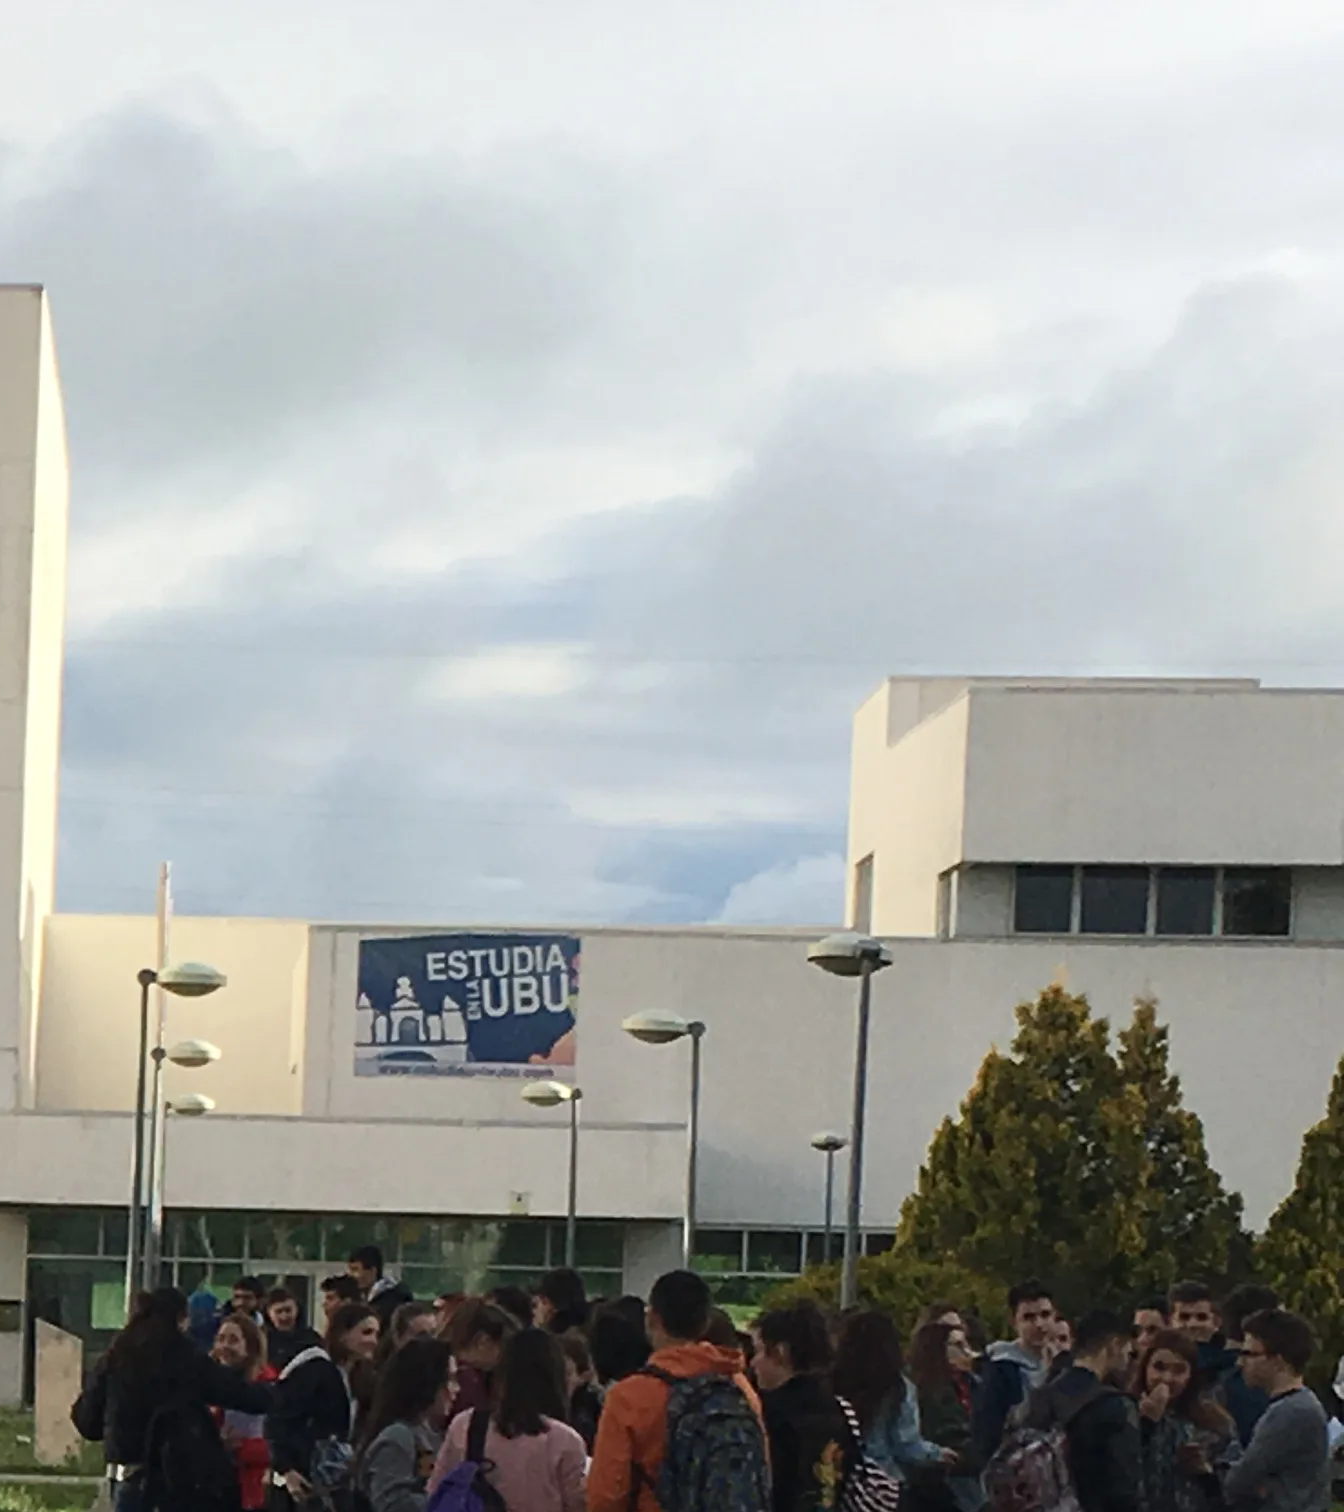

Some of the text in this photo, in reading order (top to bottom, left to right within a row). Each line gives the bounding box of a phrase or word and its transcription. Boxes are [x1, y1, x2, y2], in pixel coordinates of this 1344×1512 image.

[426, 943, 568, 981] ESTUDIA
[466, 980, 482, 1020] EN LA
[482, 973, 570, 1018] UBU
